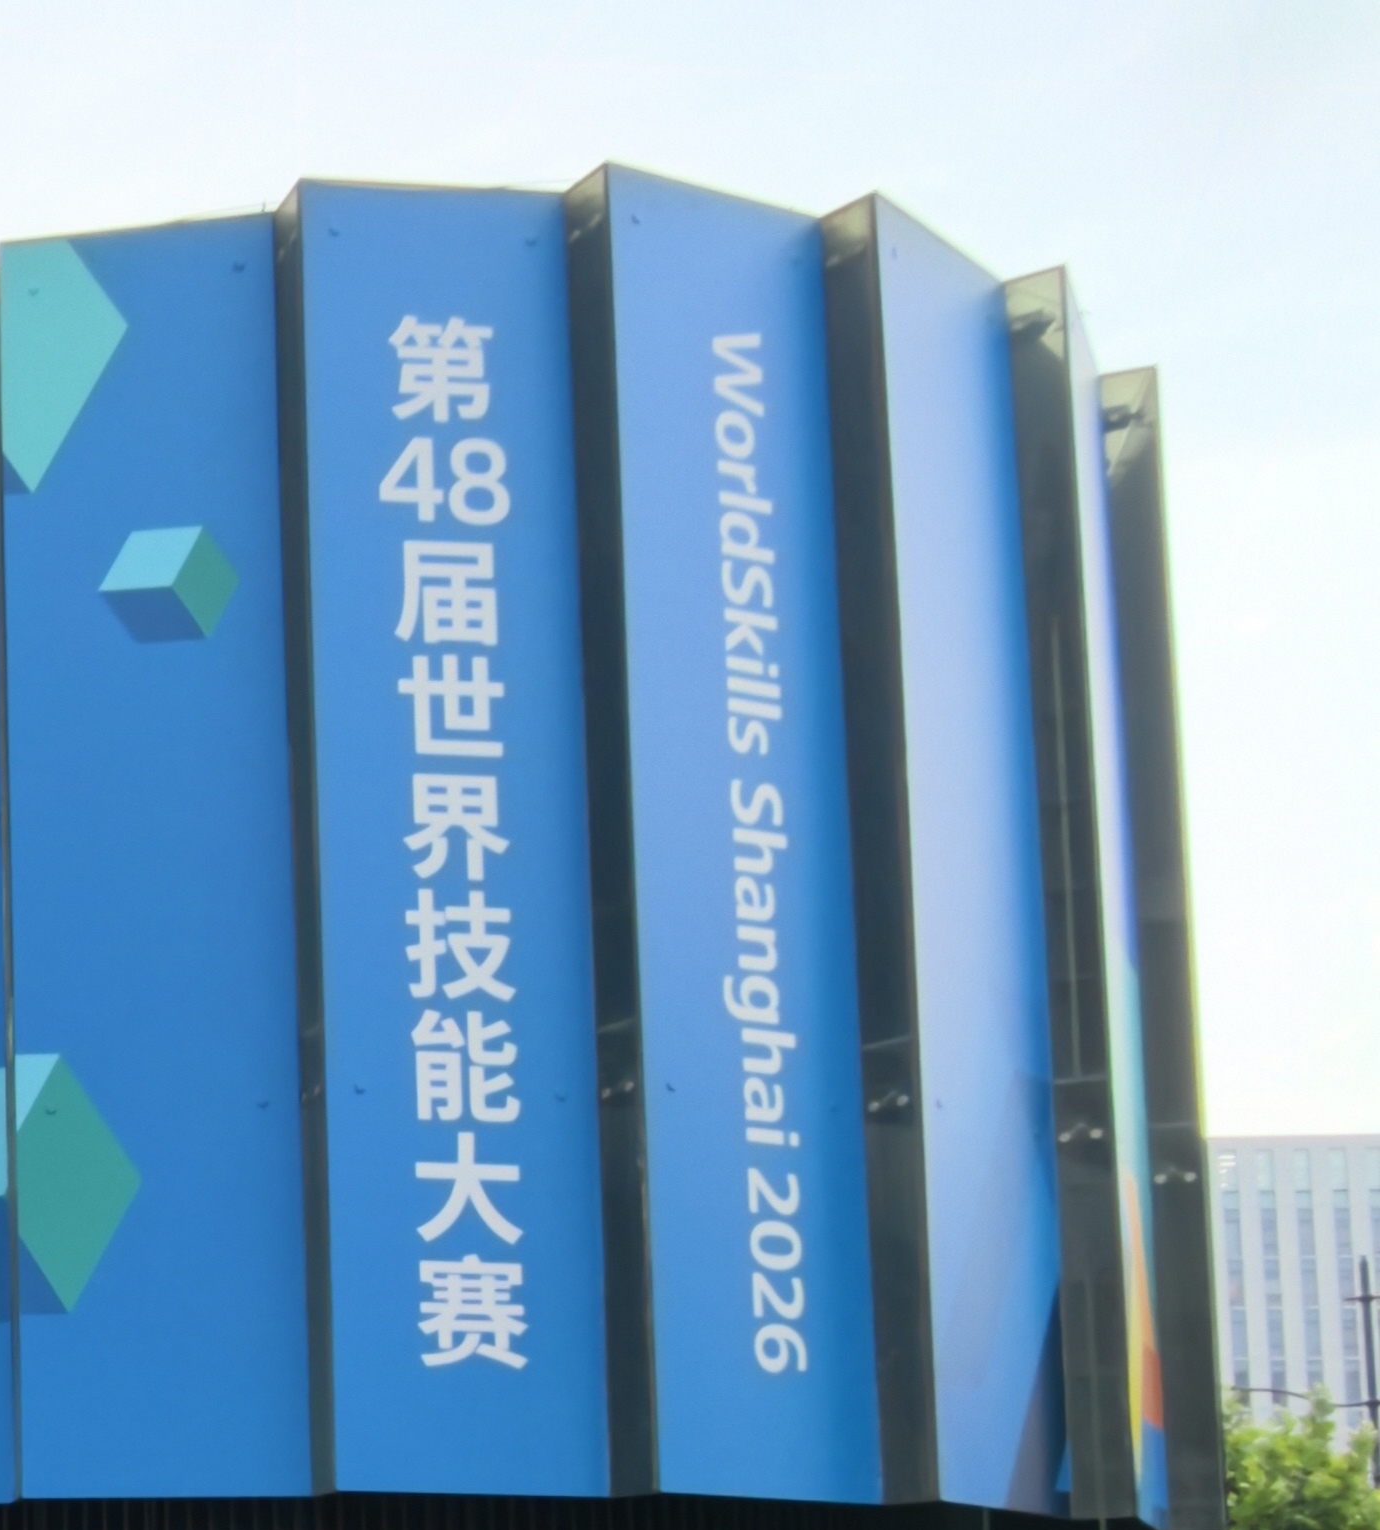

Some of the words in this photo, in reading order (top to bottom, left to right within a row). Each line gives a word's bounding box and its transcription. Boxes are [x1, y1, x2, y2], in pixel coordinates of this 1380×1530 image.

[711, 332, 783, 756] WorldSkills
[378, 314, 529, 1370] 第48届世界技能大赛
[723, 778, 800, 1147] Shanghai
[747, 1167, 807, 1373] 2026
